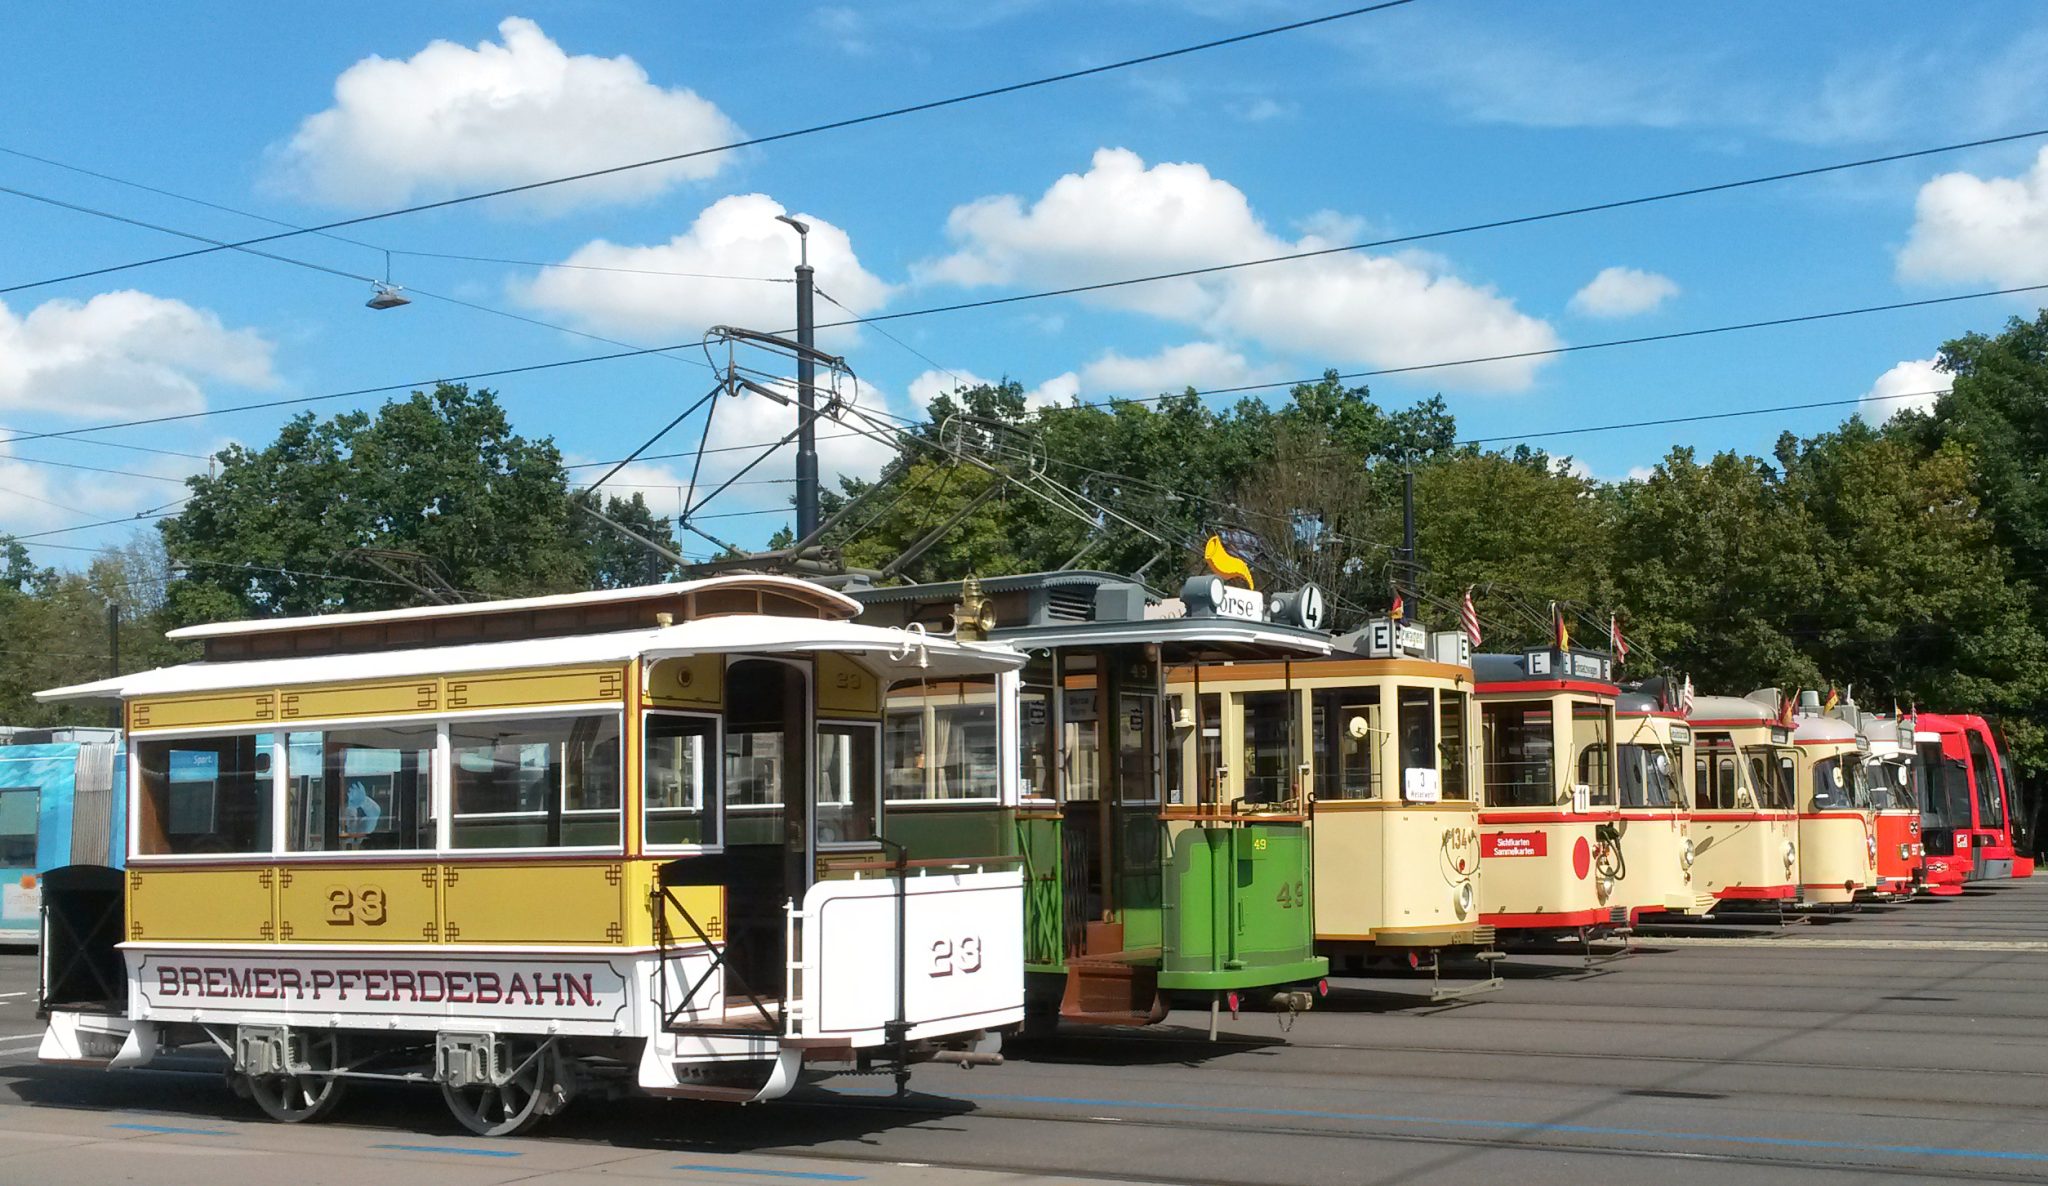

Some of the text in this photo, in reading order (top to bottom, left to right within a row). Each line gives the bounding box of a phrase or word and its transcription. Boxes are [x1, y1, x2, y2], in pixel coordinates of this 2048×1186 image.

[1306, 587, 1317, 628] 4
[1375, 626, 1388, 649] E
[1533, 654, 1542, 674] E
[836, 672, 862, 690] 23
[193, 754, 213, 766] Sport
[1253, 839, 1267, 850] 49
[1493, 847, 1535, 856] Sammelkarten
[325, 884, 387, 926] 23
[1276, 881, 1303, 909] 49
[928, 934, 981, 978] 23
